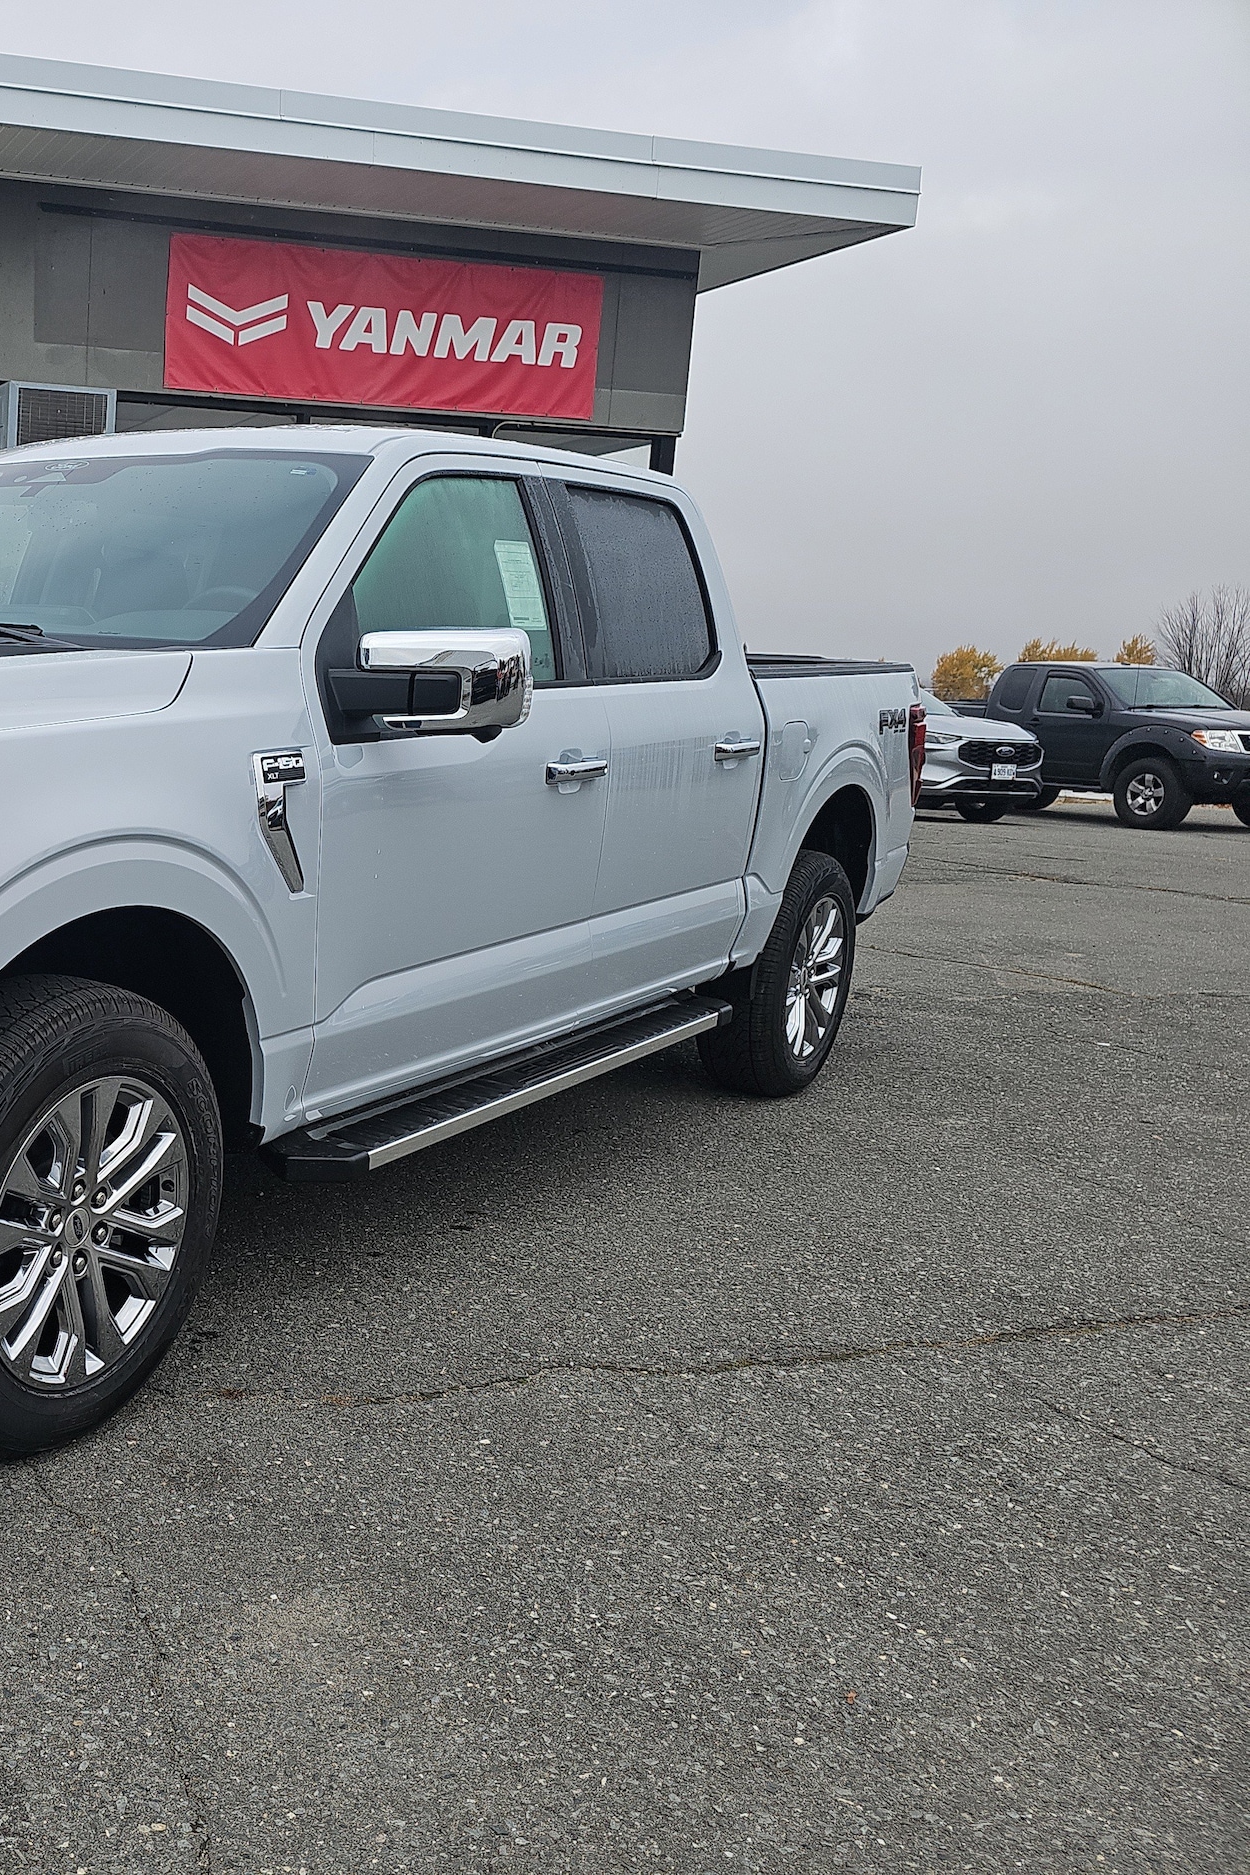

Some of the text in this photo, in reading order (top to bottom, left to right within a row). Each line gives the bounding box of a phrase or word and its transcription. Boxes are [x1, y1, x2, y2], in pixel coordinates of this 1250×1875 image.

[307, 300, 582, 369] YANMAR
[879, 708, 907, 735] FX4
[262, 756, 304, 771] F-150
[267, 772, 279, 780] XLT
